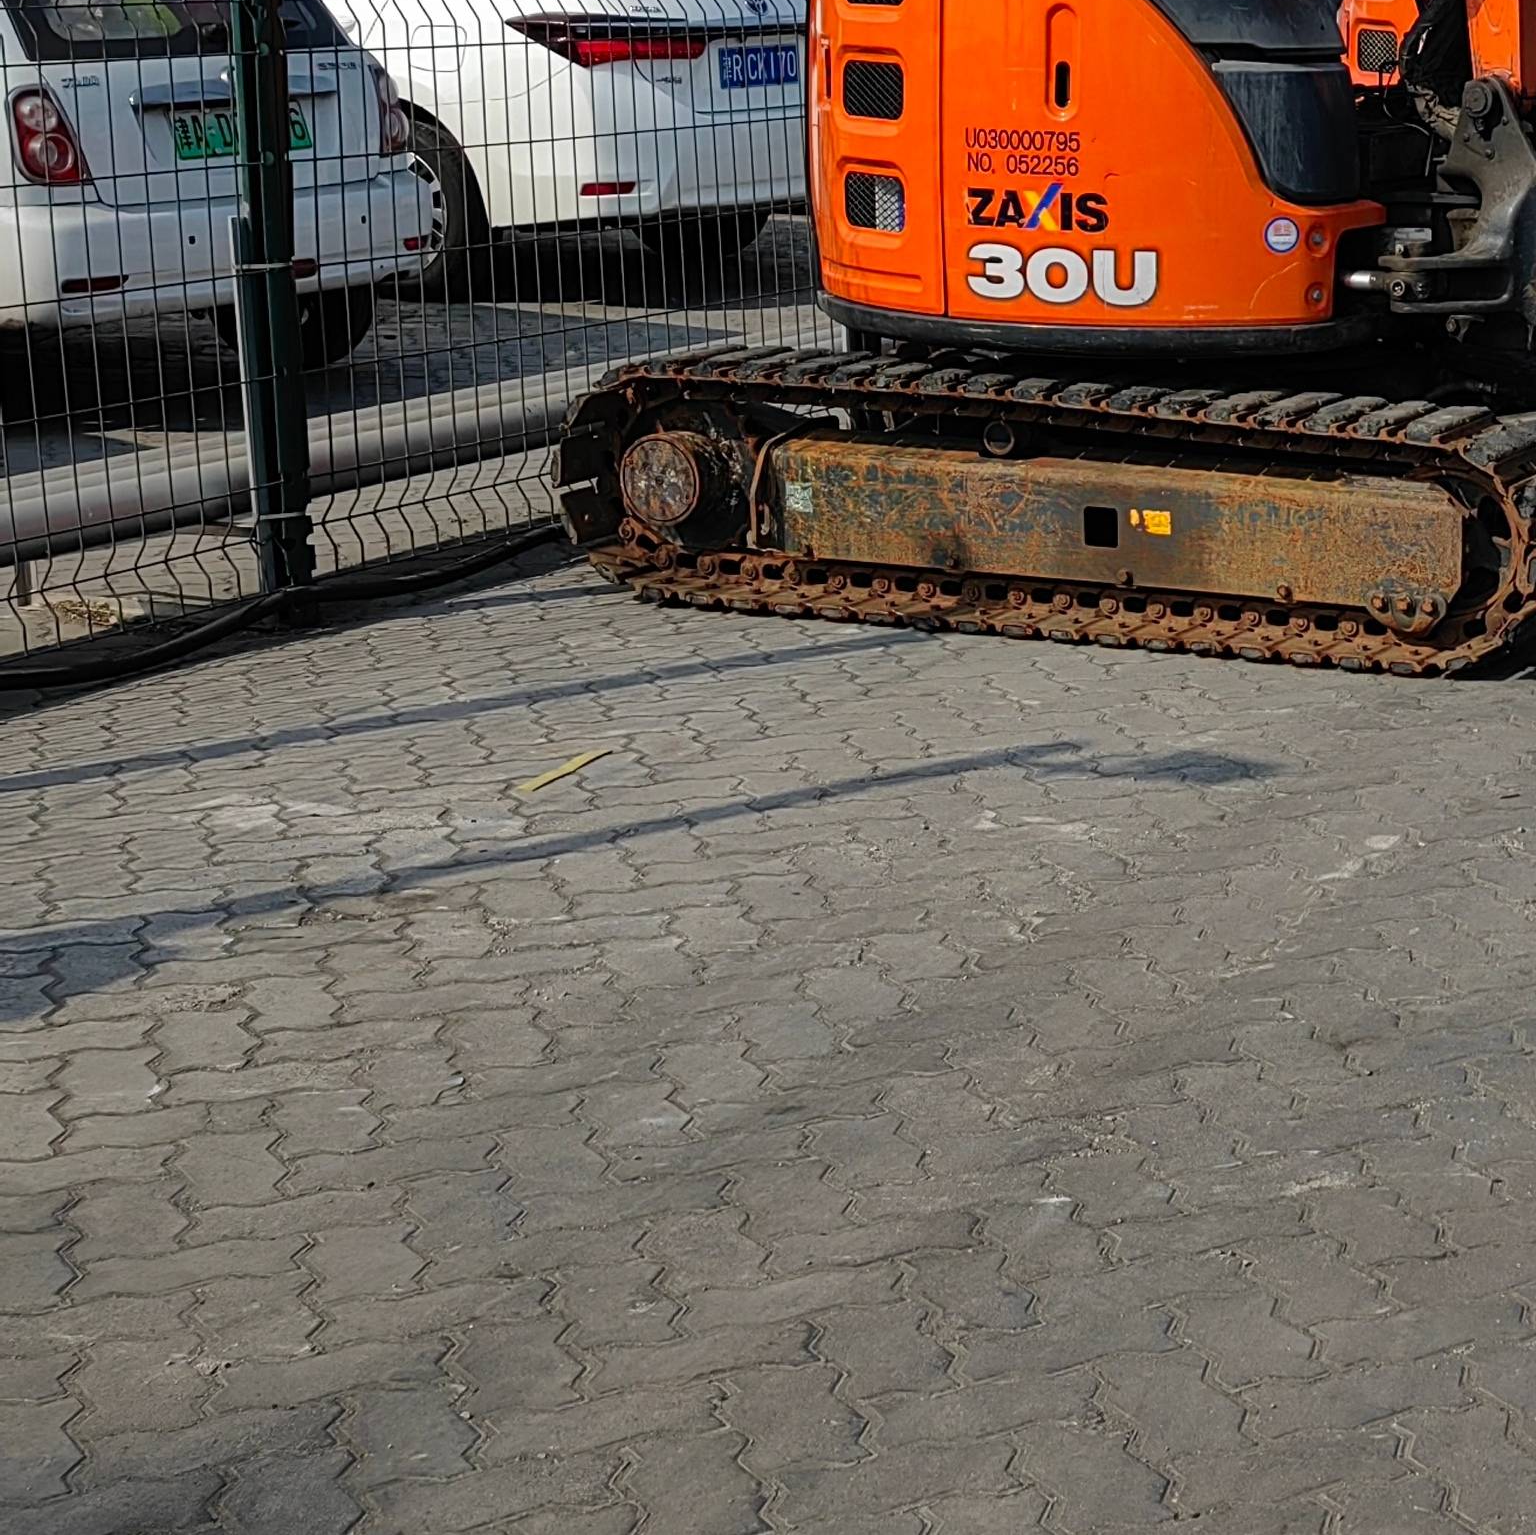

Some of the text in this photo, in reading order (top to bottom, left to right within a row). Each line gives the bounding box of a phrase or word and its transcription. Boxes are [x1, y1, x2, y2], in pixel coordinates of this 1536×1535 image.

[965, 128, 1080, 153] U030000795
[968, 153, 1079, 176] NO. 052256
[967, 183, 1110, 234] ZAXIS
[967, 242, 1158, 307] 30U
